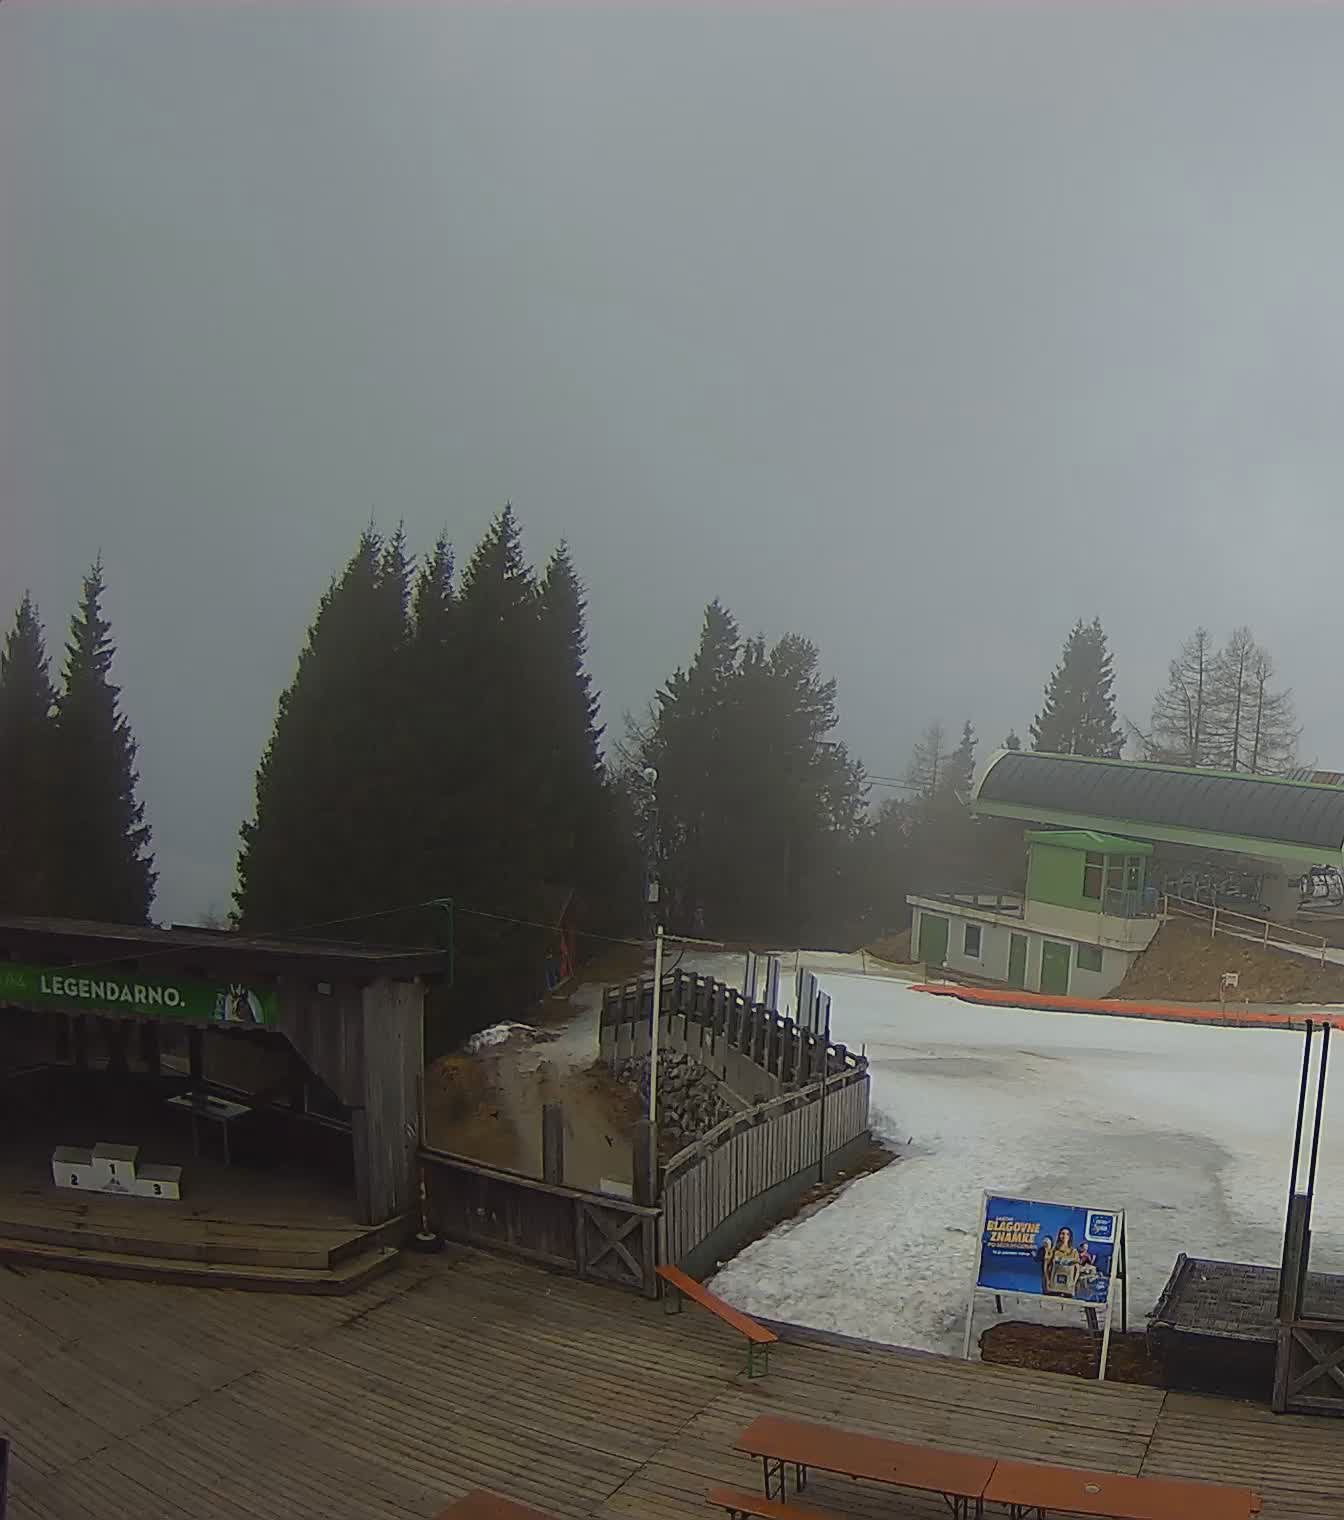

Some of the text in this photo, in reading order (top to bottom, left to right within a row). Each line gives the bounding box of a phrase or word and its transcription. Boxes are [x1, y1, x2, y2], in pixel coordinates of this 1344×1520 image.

[39, 974, 187, 1008] LEGENDARNO.
[109, 1163, 117, 1175] 1
[71, 1173, 79, 1186] 2
[153, 1183, 162, 1196] 3
